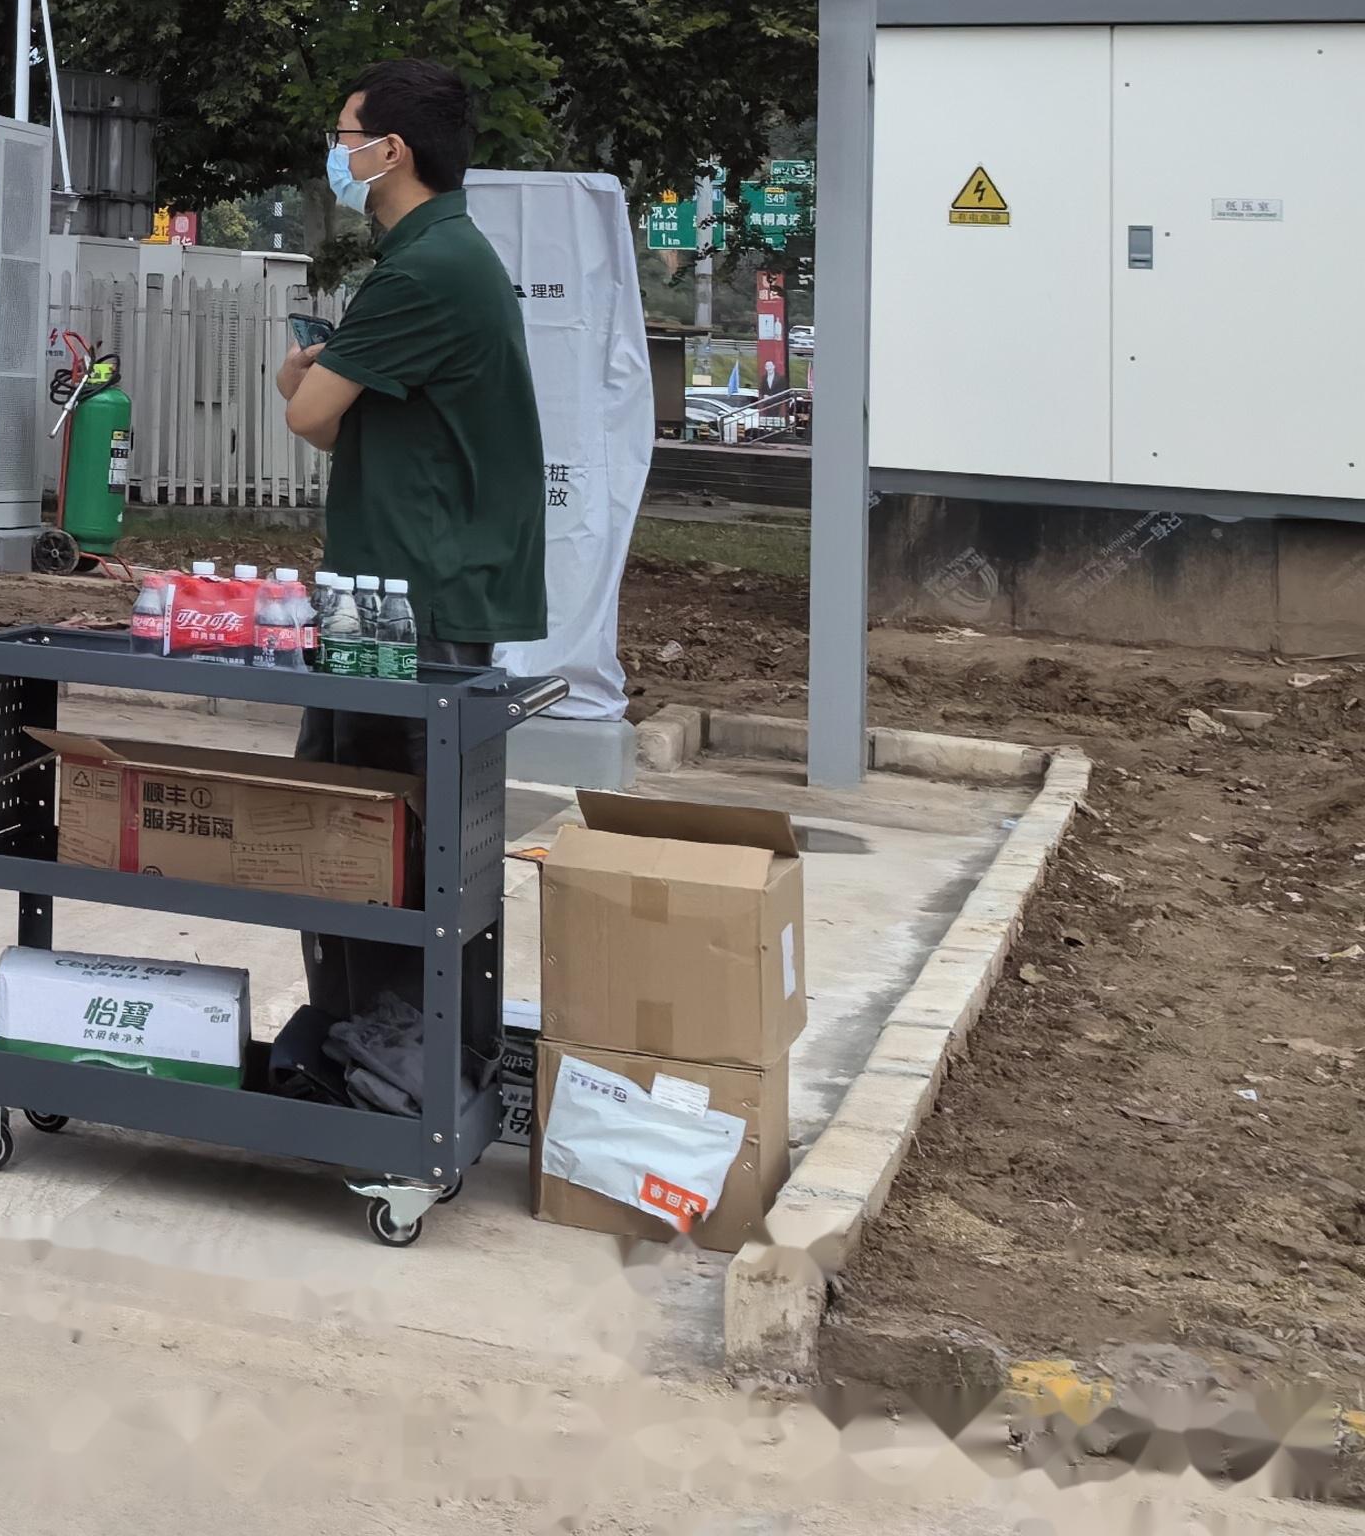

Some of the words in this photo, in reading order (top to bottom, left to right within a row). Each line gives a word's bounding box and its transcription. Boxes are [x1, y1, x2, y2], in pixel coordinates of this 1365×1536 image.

[651, 206, 678, 219] 巩义
[531, 283, 565, 299] 理想
[544, 463, 570, 482] 桩
[175, 608, 248, 633] 可口可乐
[142, 808, 234, 840] 服务指南
[82, 1027, 145, 1046] 饮用纯净水
